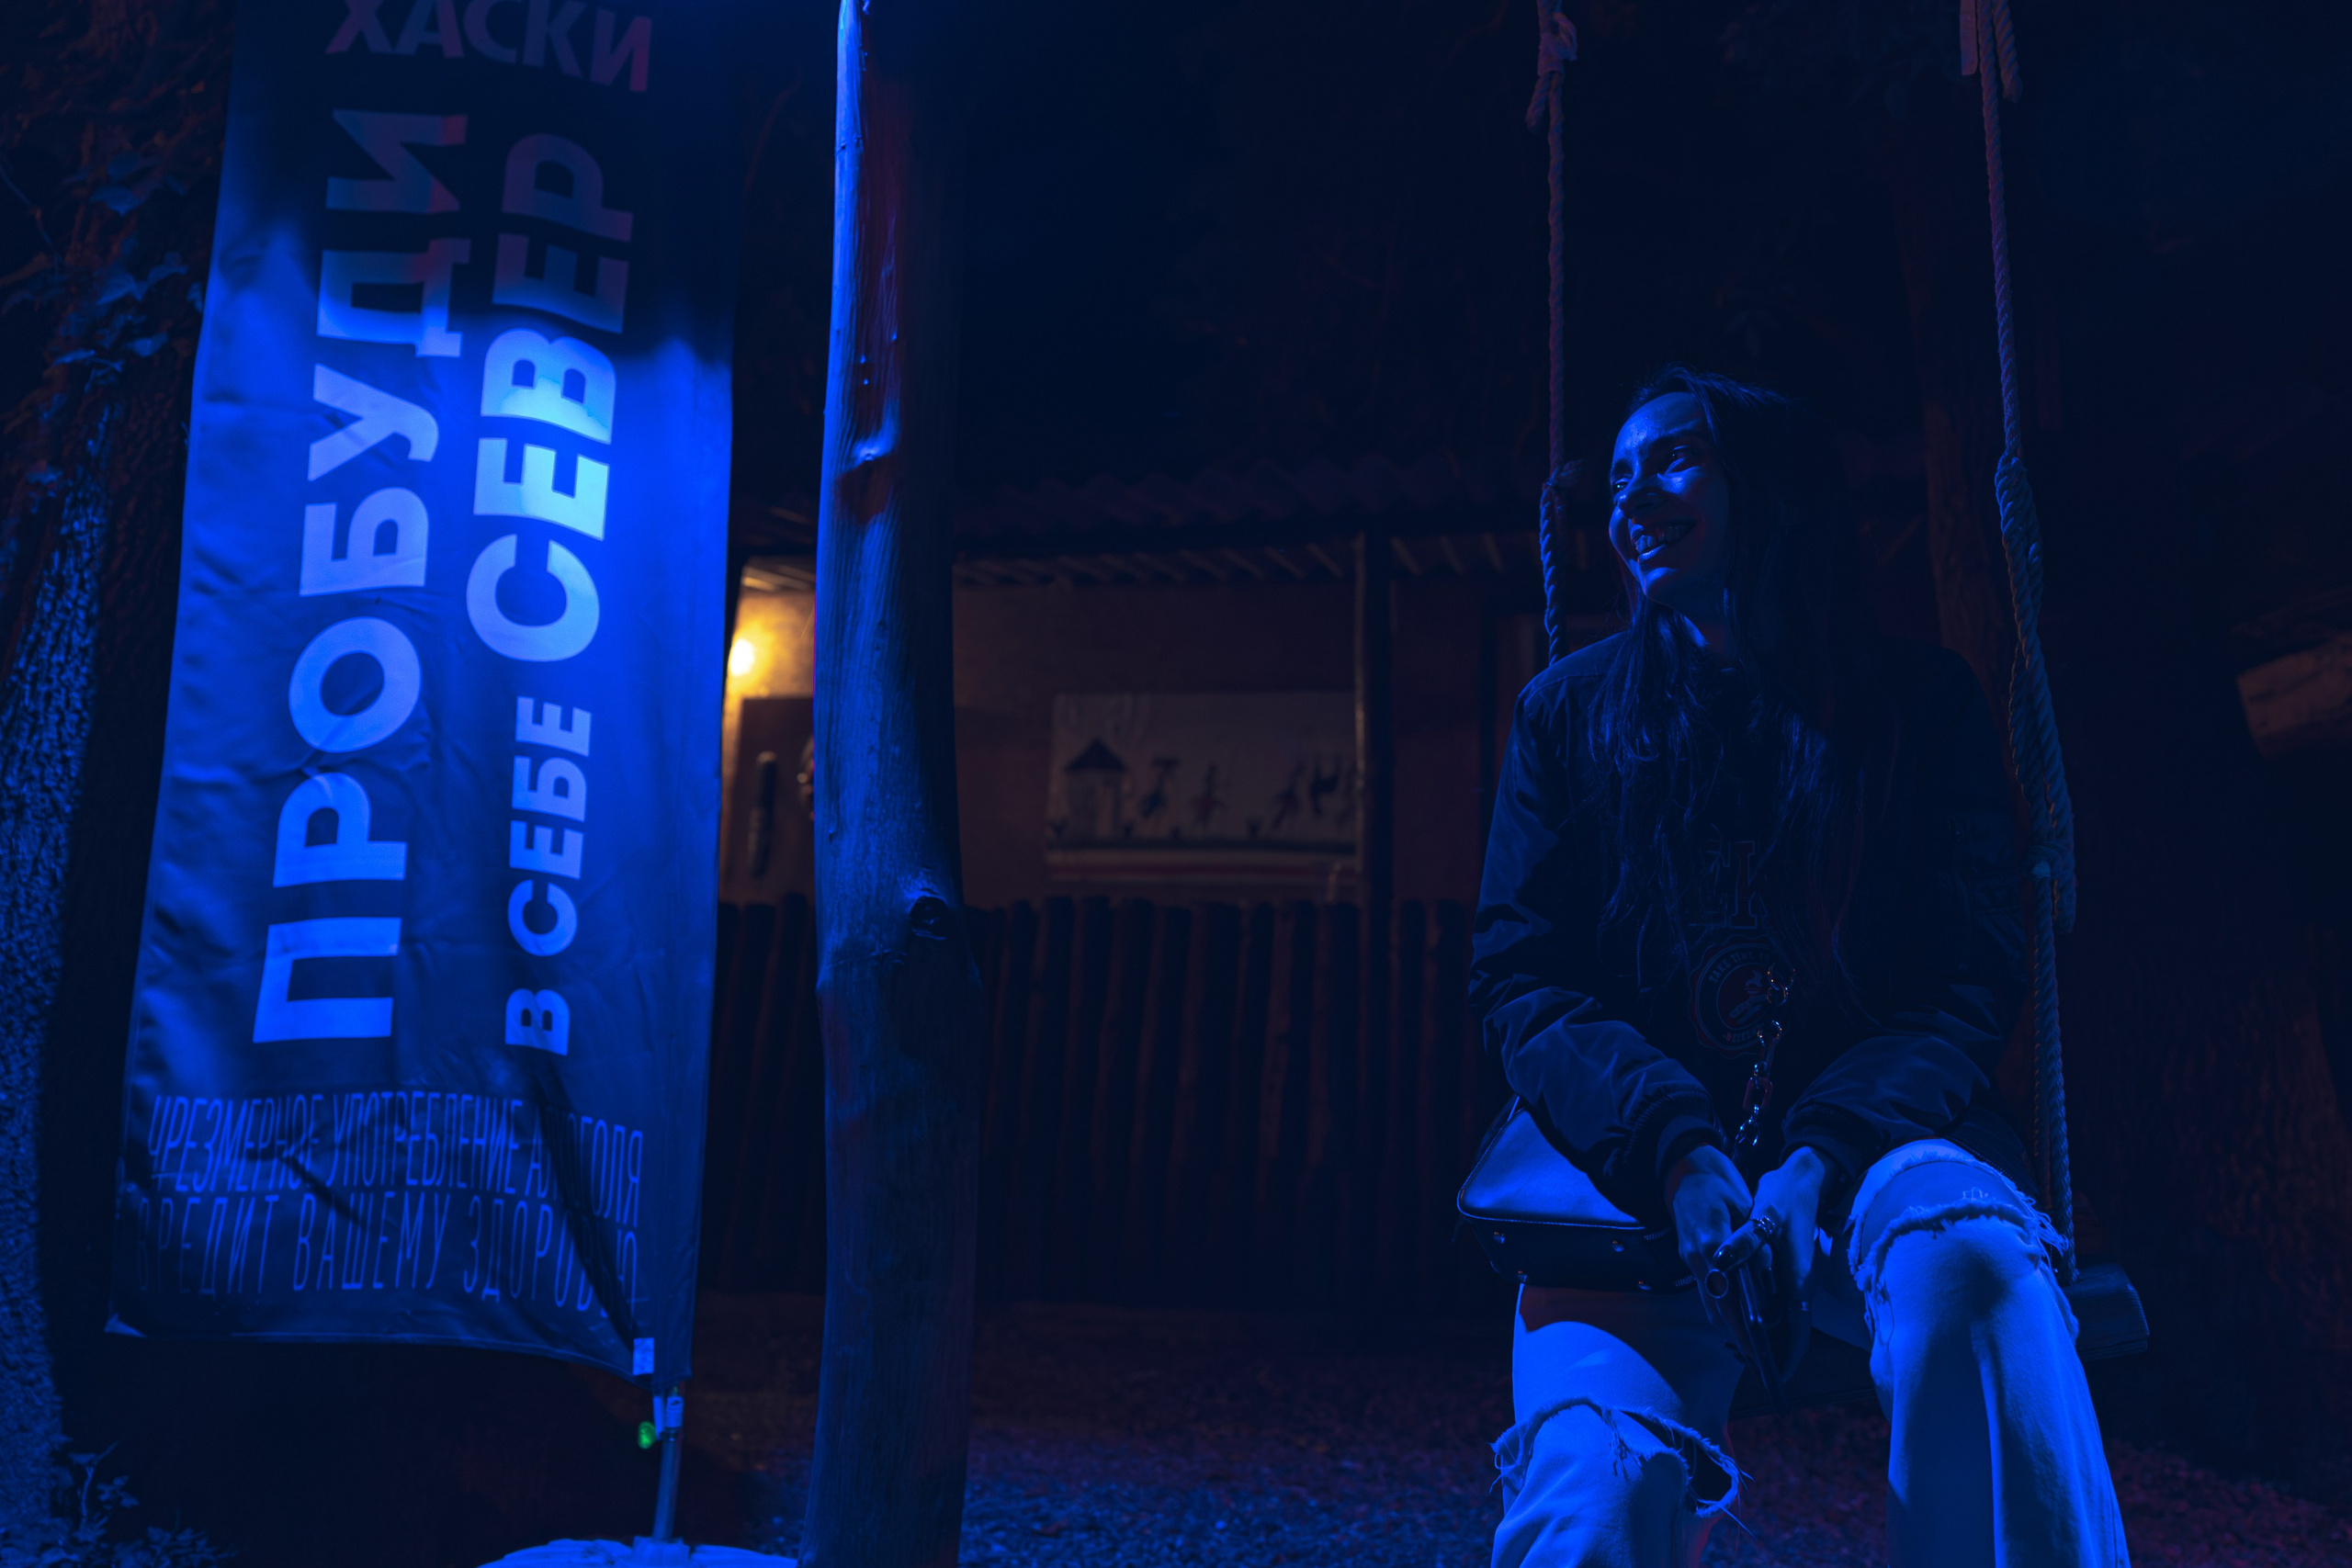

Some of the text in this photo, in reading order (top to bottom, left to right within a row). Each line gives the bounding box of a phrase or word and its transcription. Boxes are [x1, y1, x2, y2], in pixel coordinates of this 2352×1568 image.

[324, 0, 653, 93] ХАСКИ
[253, 107, 471, 1043] ПРОБУДИ
[466, 132, 634, 1056] В СЕБЕ СЕВЕР
[147, 1094, 324, 1193] ЧРЕЗМЕРНОЕ
[325, 1090, 524, 1196] УПОТРЕБЛЕНИЕ
[136, 1195, 279, 1302] ВРЕДИТ
[292, 1191, 450, 1292] ВАШЕМУ
